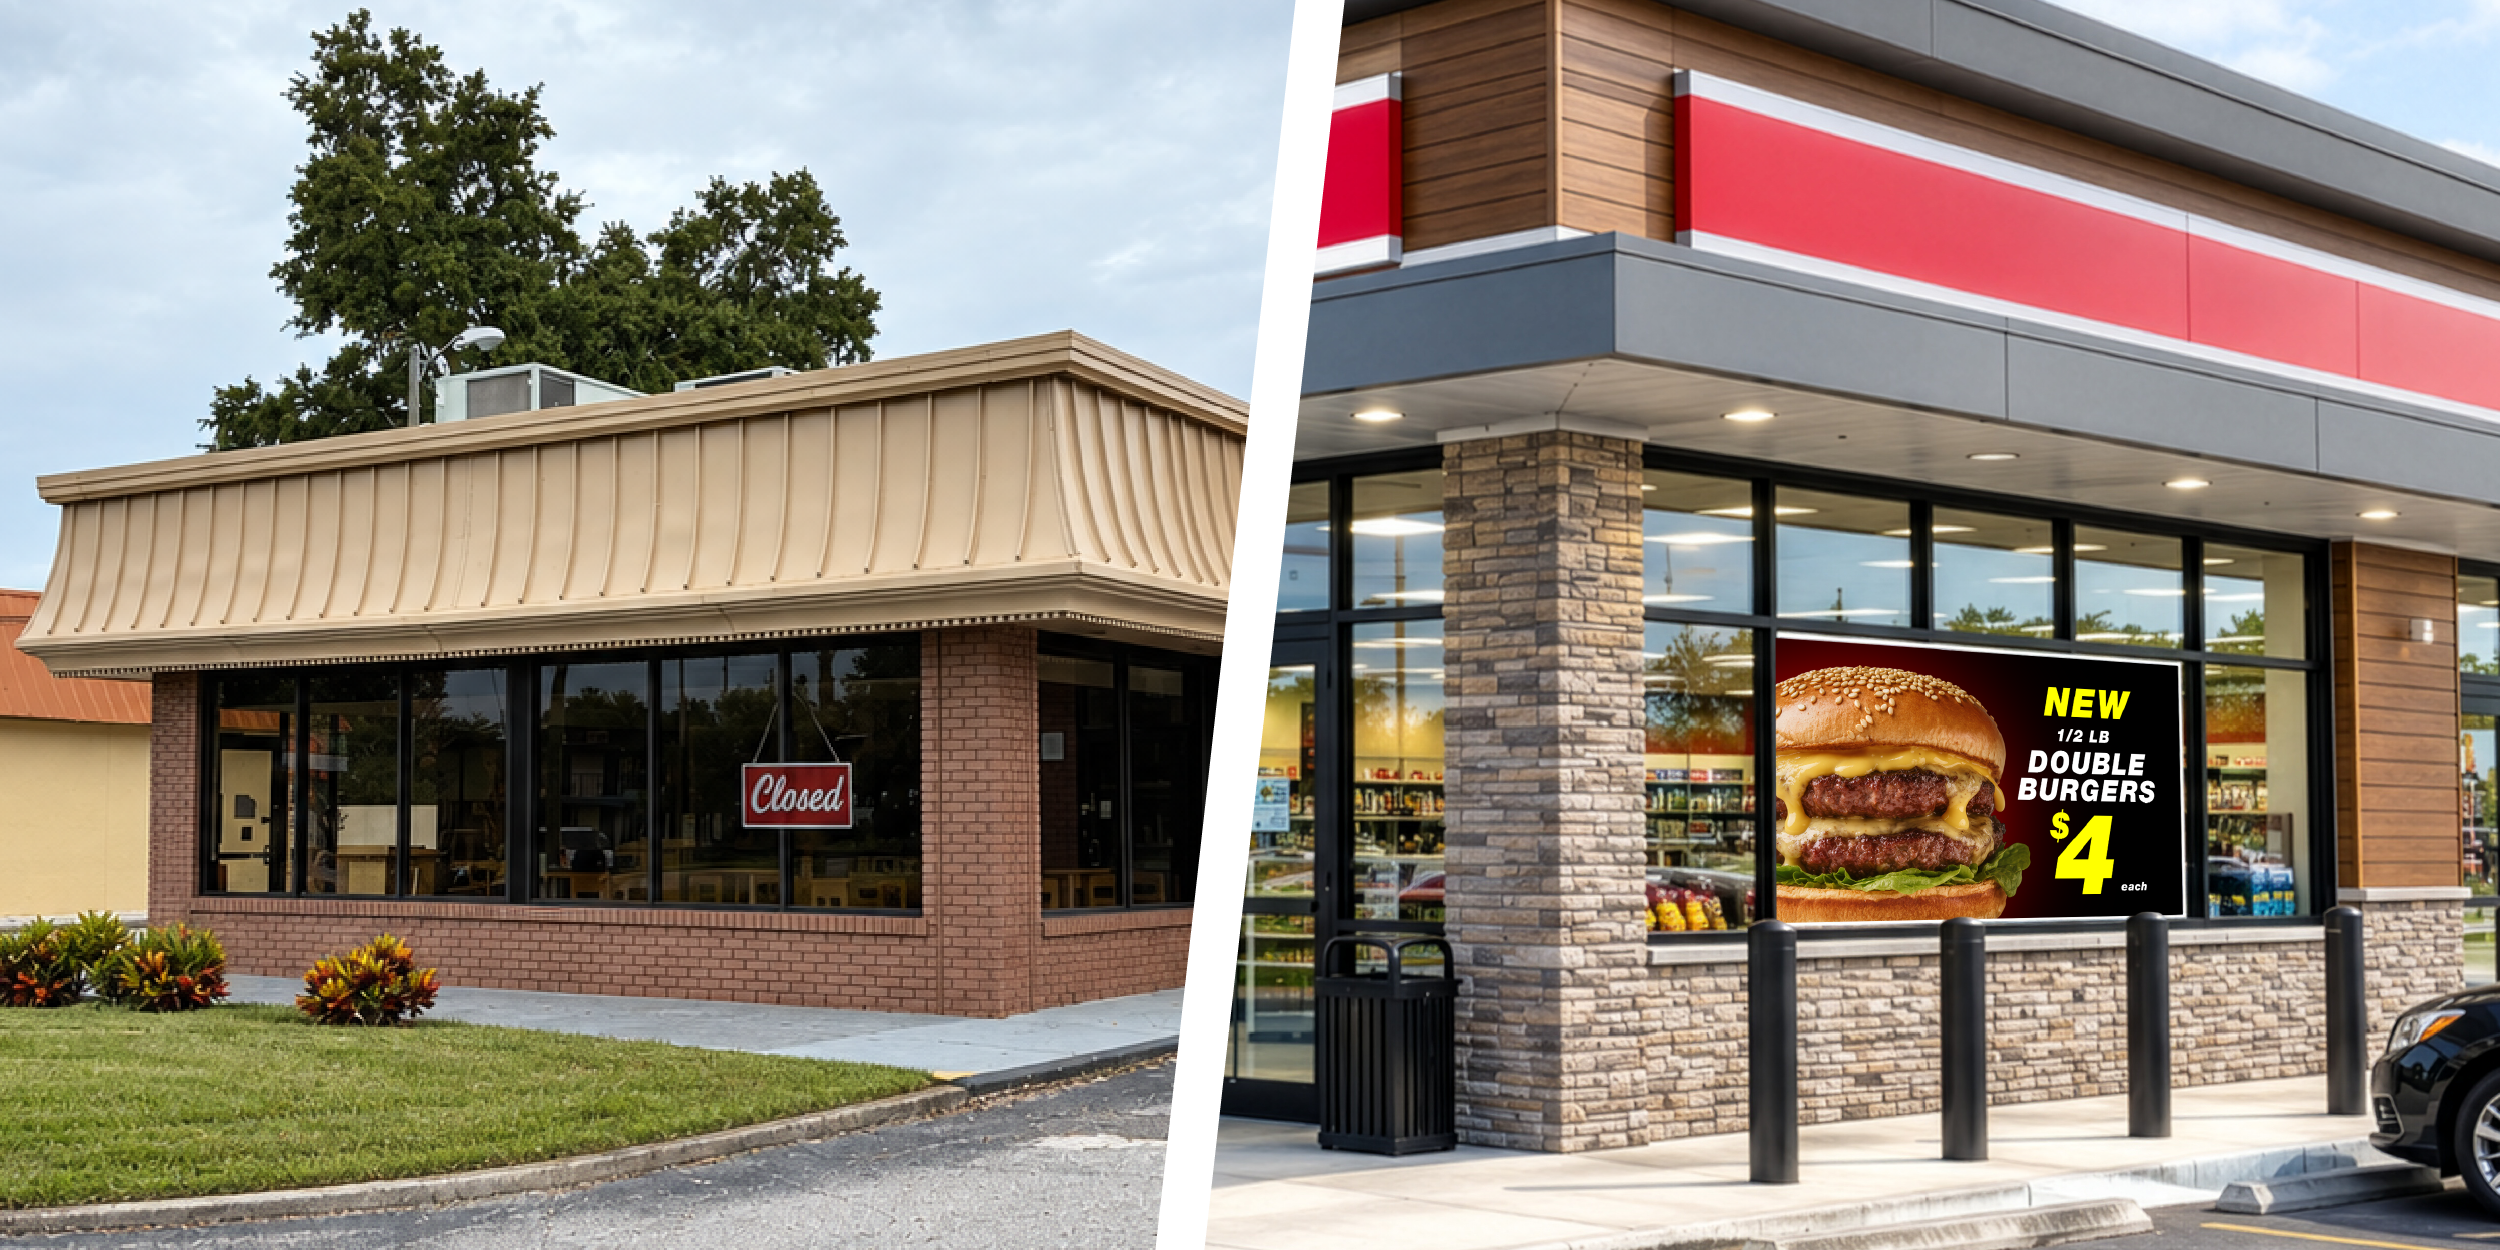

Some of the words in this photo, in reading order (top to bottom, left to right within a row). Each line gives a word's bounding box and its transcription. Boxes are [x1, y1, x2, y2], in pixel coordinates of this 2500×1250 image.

[2043, 686, 2131, 720] NEW
[2057, 729, 2084, 743] 1/2
[2088, 730, 2110, 744] LB
[2027, 749, 2146, 776] DOUBLE
[751, 773, 845, 813] Closed
[2017, 777, 2156, 804] BURGERS
[2049, 809, 2115, 895] $4
[2120, 881, 2148, 892] each
